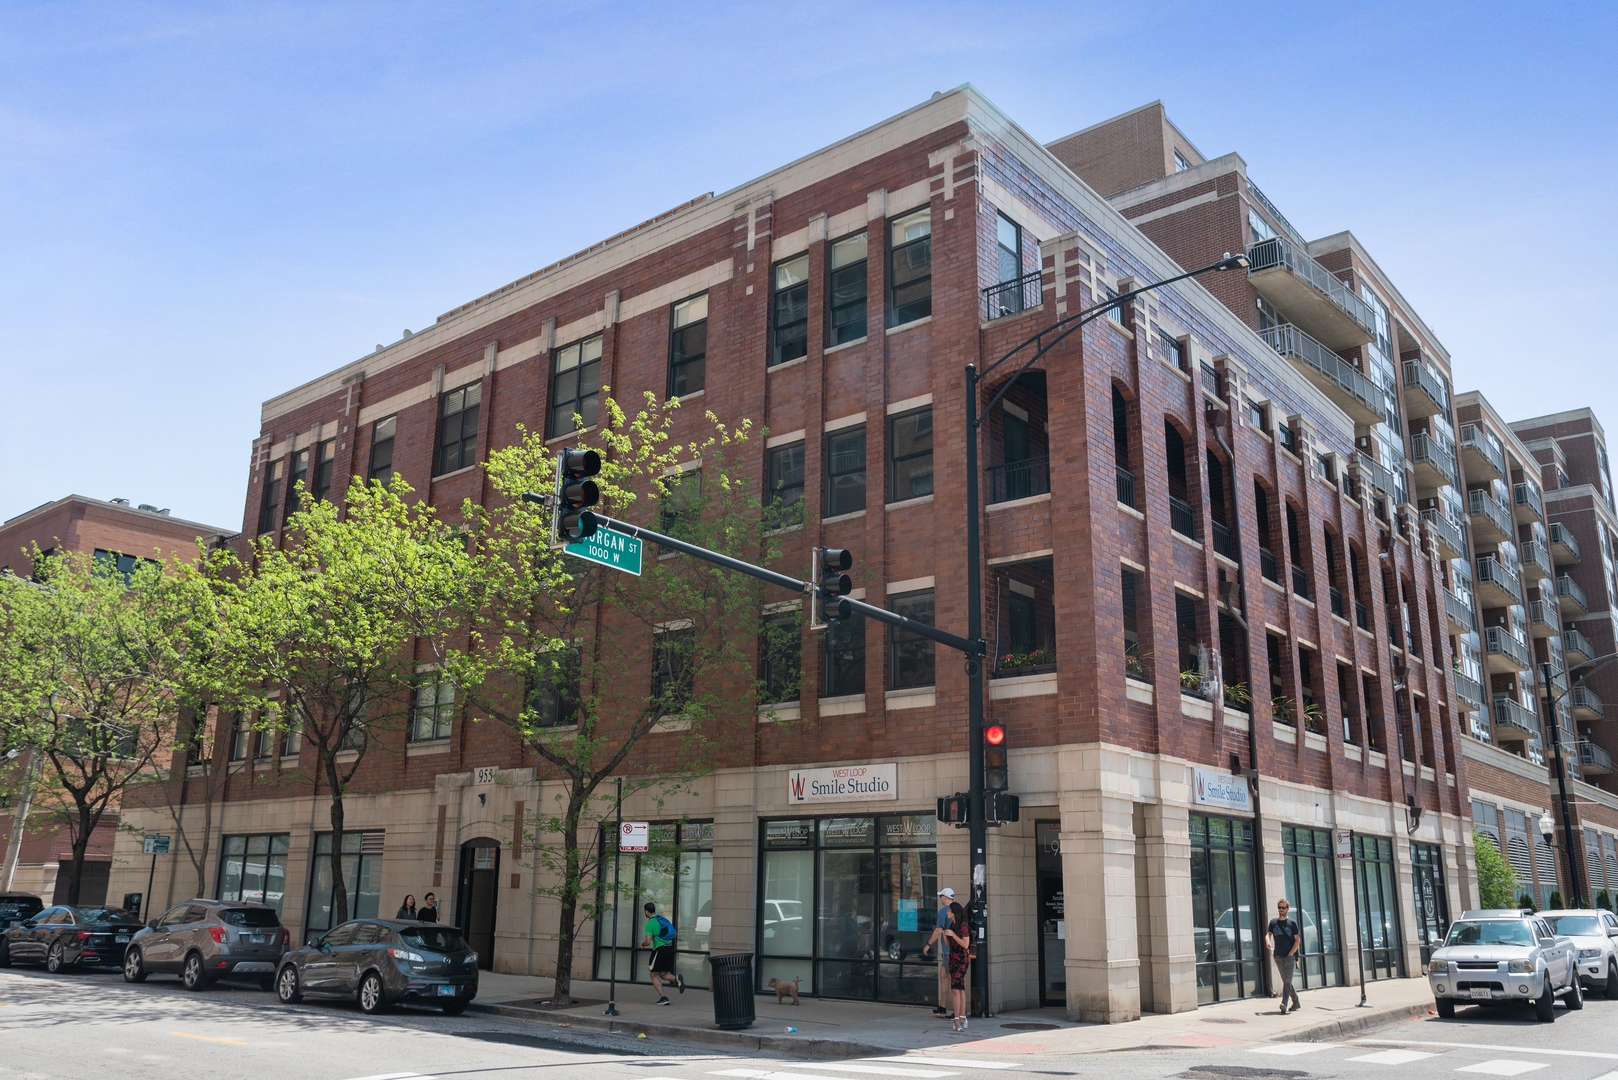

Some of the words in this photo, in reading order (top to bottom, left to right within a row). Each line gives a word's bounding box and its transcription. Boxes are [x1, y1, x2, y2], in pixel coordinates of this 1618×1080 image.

[584, 530, 624, 552] ORGAN
[628, 543, 637, 554] ST
[588, 545, 608, 560] 1000
[613, 553, 620, 563] W
[478, 769, 493, 783] 955
[832, 768, 849, 778] WEST
[850, 768, 867, 776] LOOP
[812, 779, 845, 795] Smile
[848, 777, 889, 794] Studio
[1208, 782, 1225, 799] Smile
[1226, 786, 1246, 803] Studio
[850, 826, 868, 834] LOOP
[886, 824, 903, 832] WEST
[913, 824, 931, 832] LOOP
